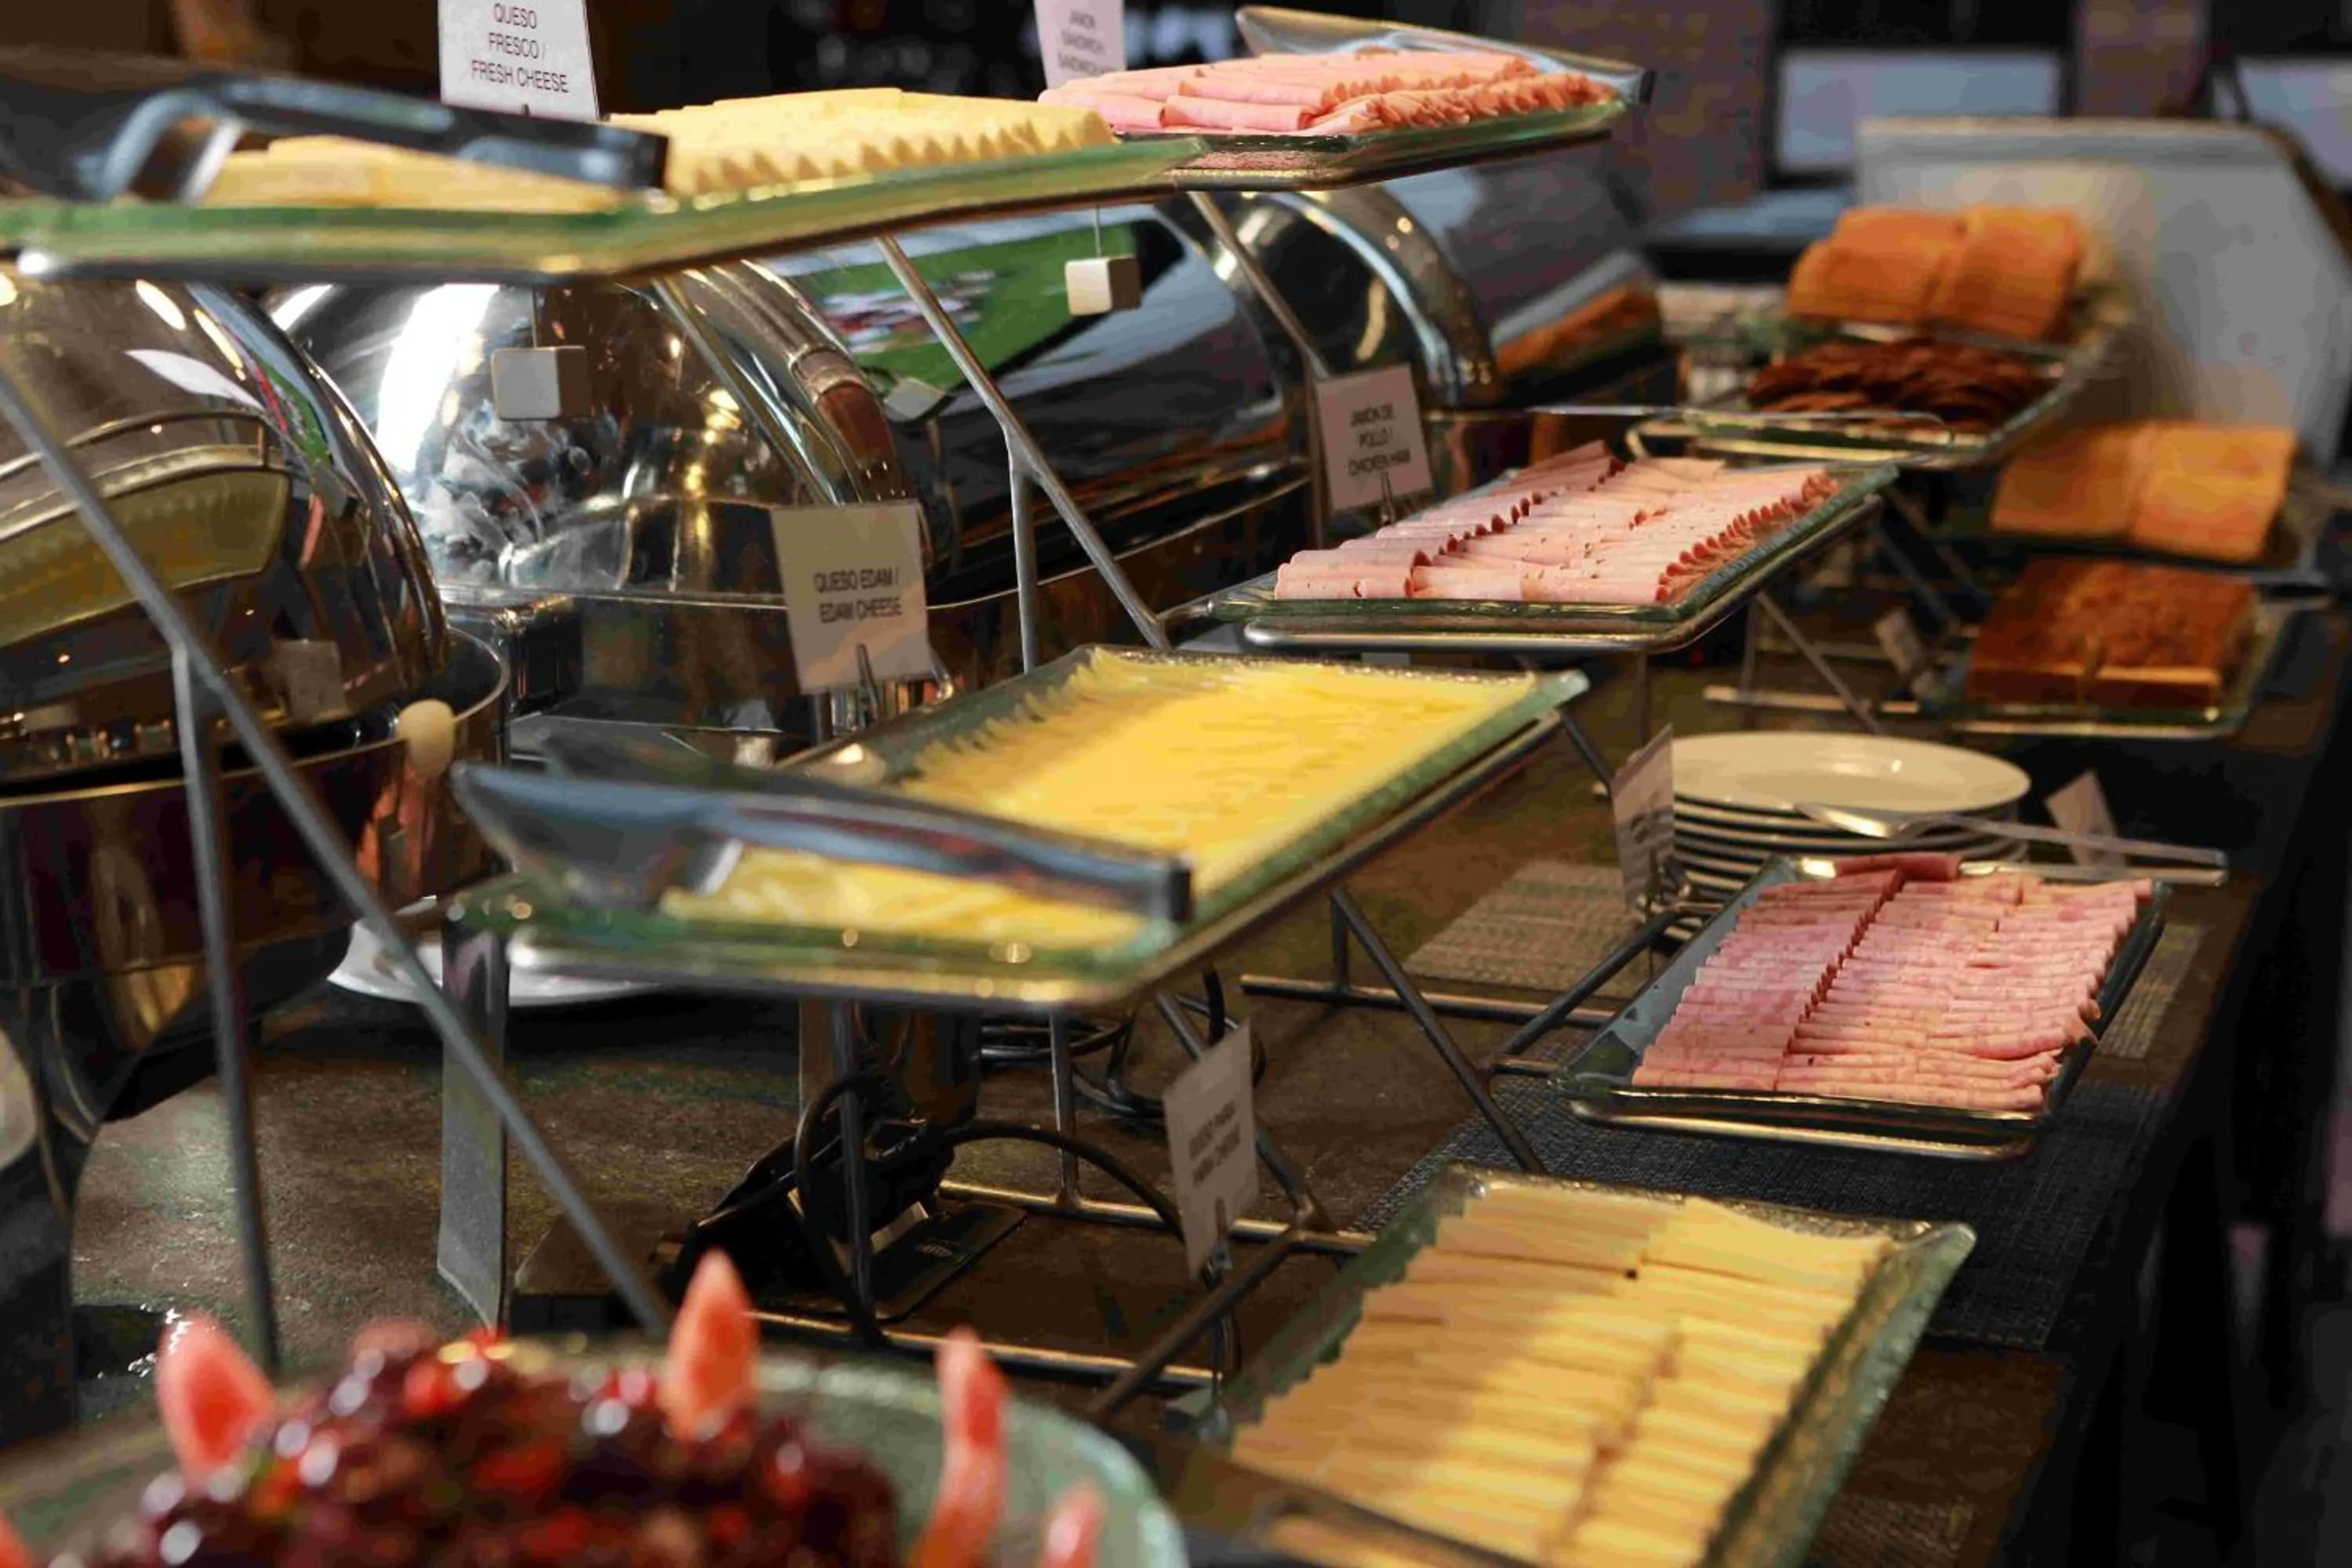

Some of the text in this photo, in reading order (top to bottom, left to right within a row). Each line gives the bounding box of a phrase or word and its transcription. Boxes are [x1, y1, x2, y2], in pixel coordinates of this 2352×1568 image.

[493, 2, 538, 29] QUESO
[488, 32, 539, 59] FRESCO
[471, 60, 569, 93] FRESH CHEESE
[813, 569, 858, 593] QUESO
[855, 597, 903, 620] CHEESE
